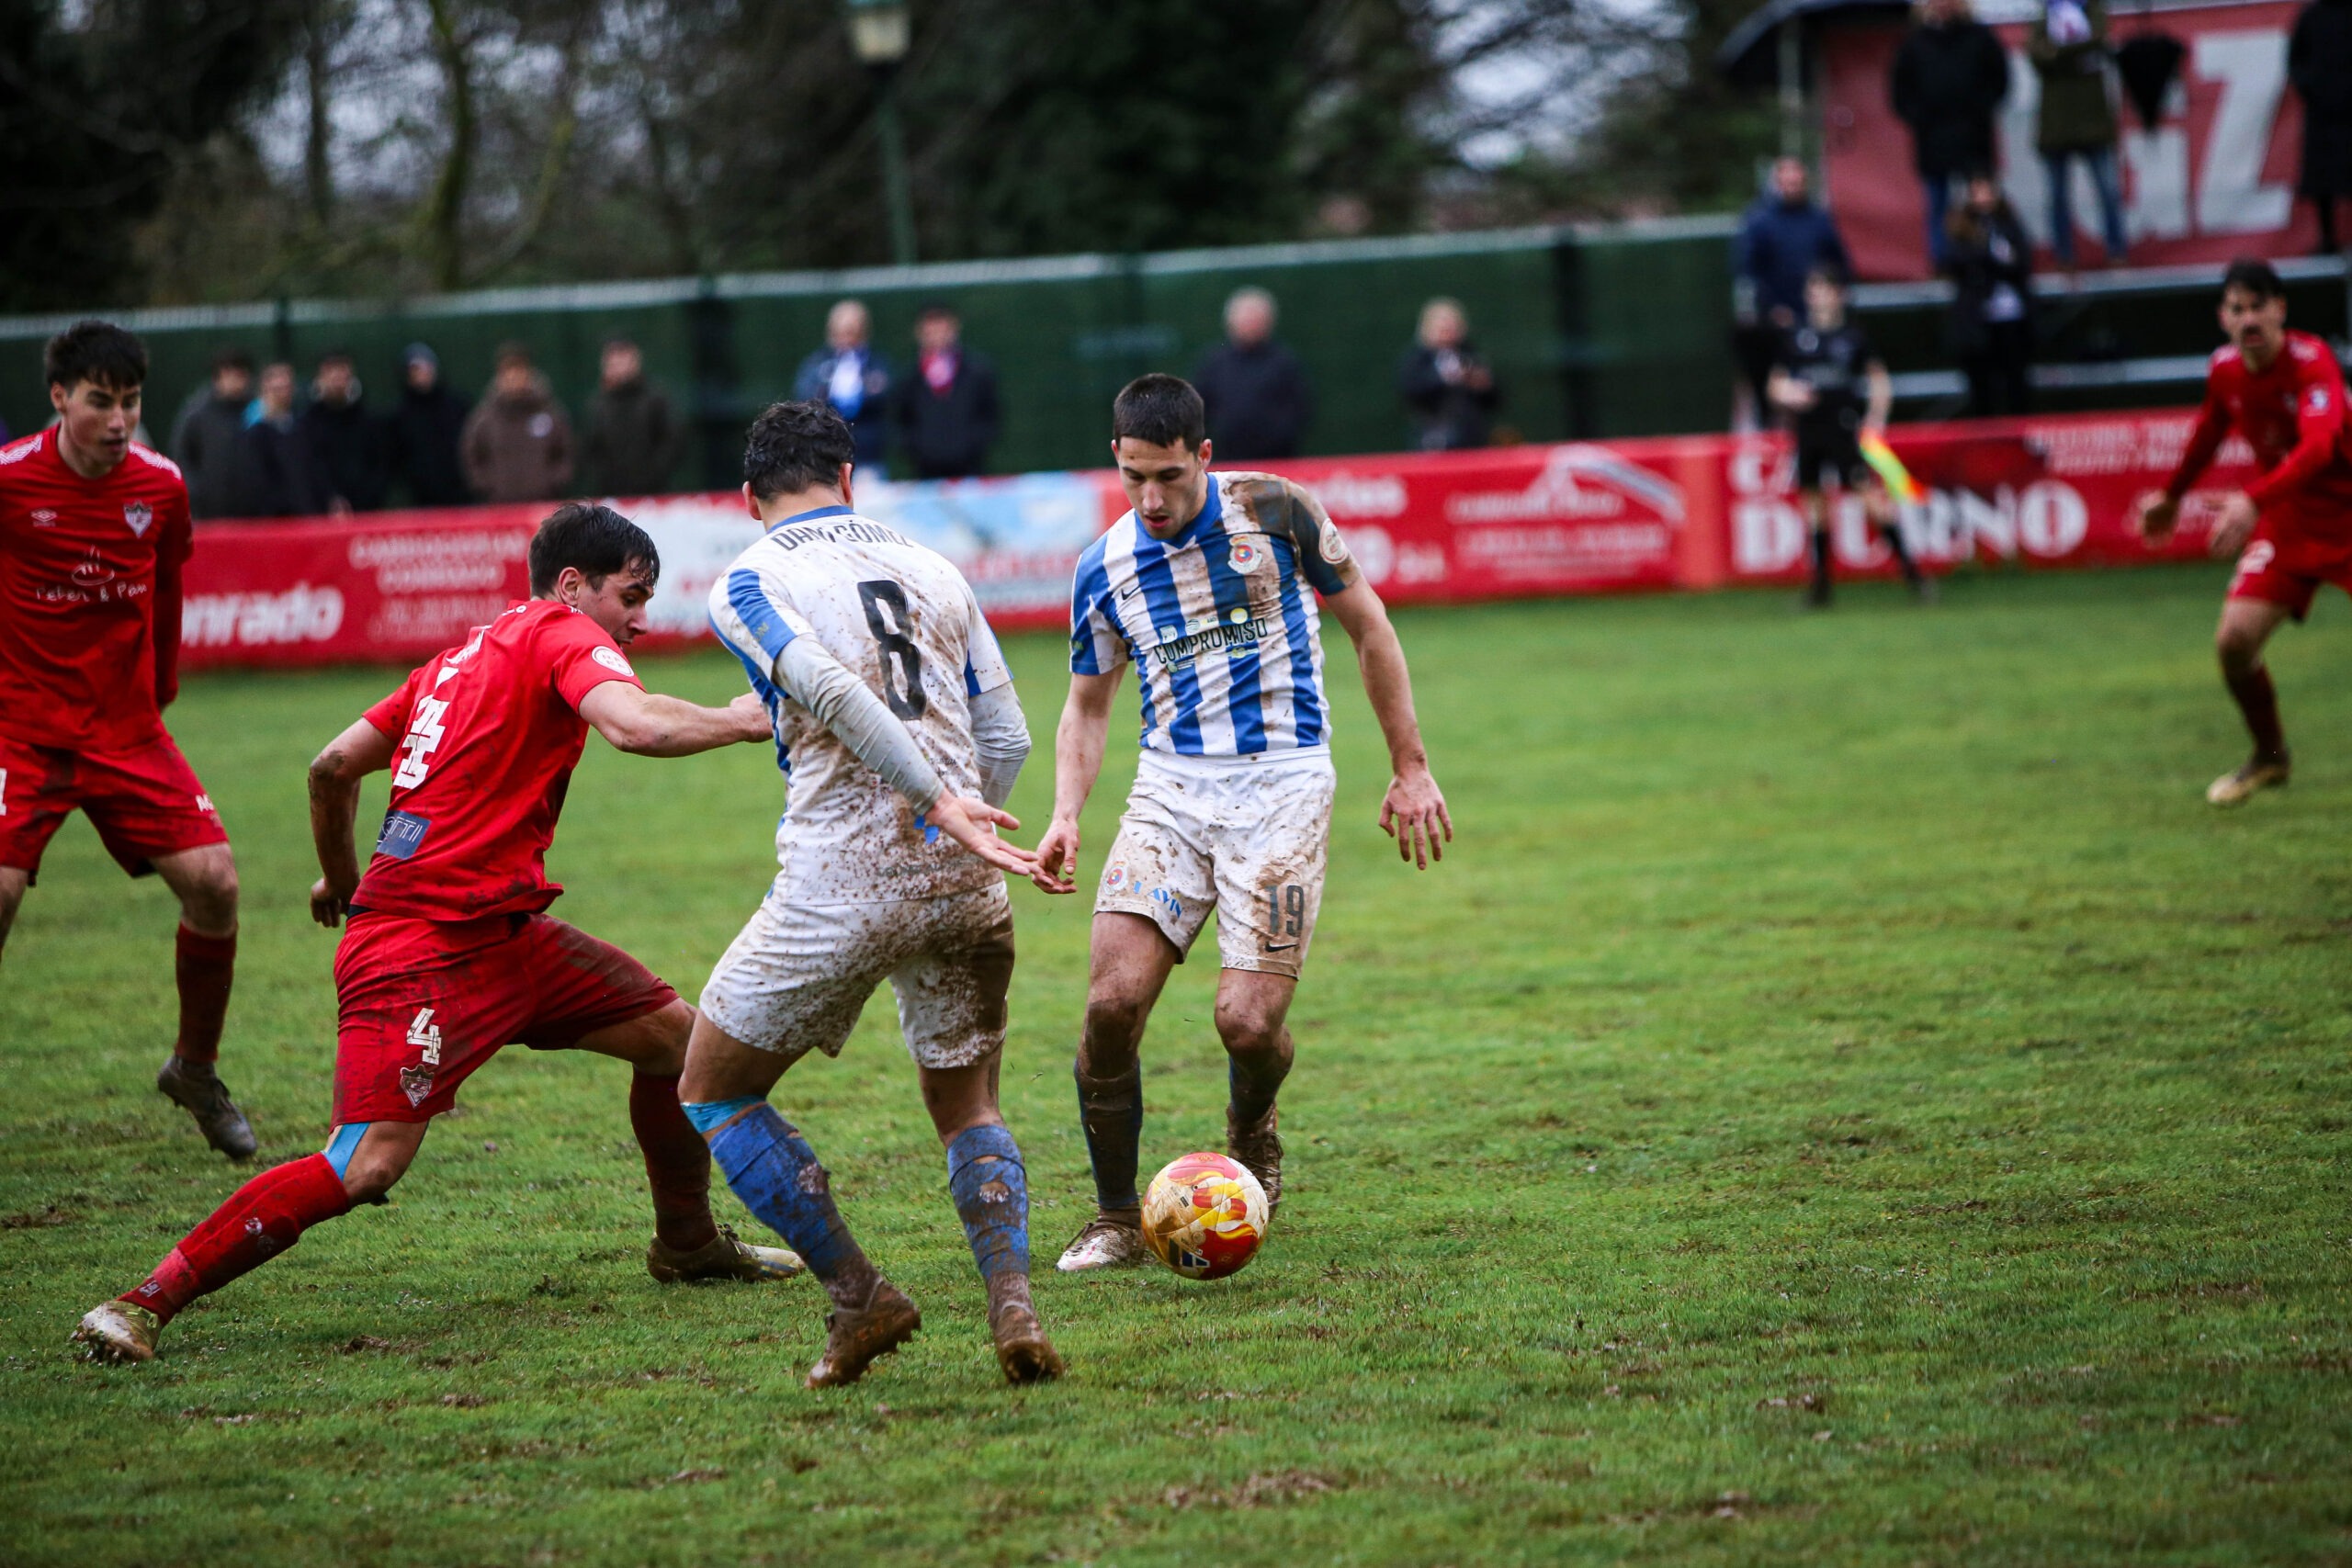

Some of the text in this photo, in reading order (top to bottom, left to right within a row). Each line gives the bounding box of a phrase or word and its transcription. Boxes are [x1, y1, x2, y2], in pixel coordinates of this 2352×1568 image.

[181, 580, 345, 647] nrado
[857, 580, 927, 721] 8
[1264, 885, 1304, 937] 19
[406, 1007, 442, 1066] 4
